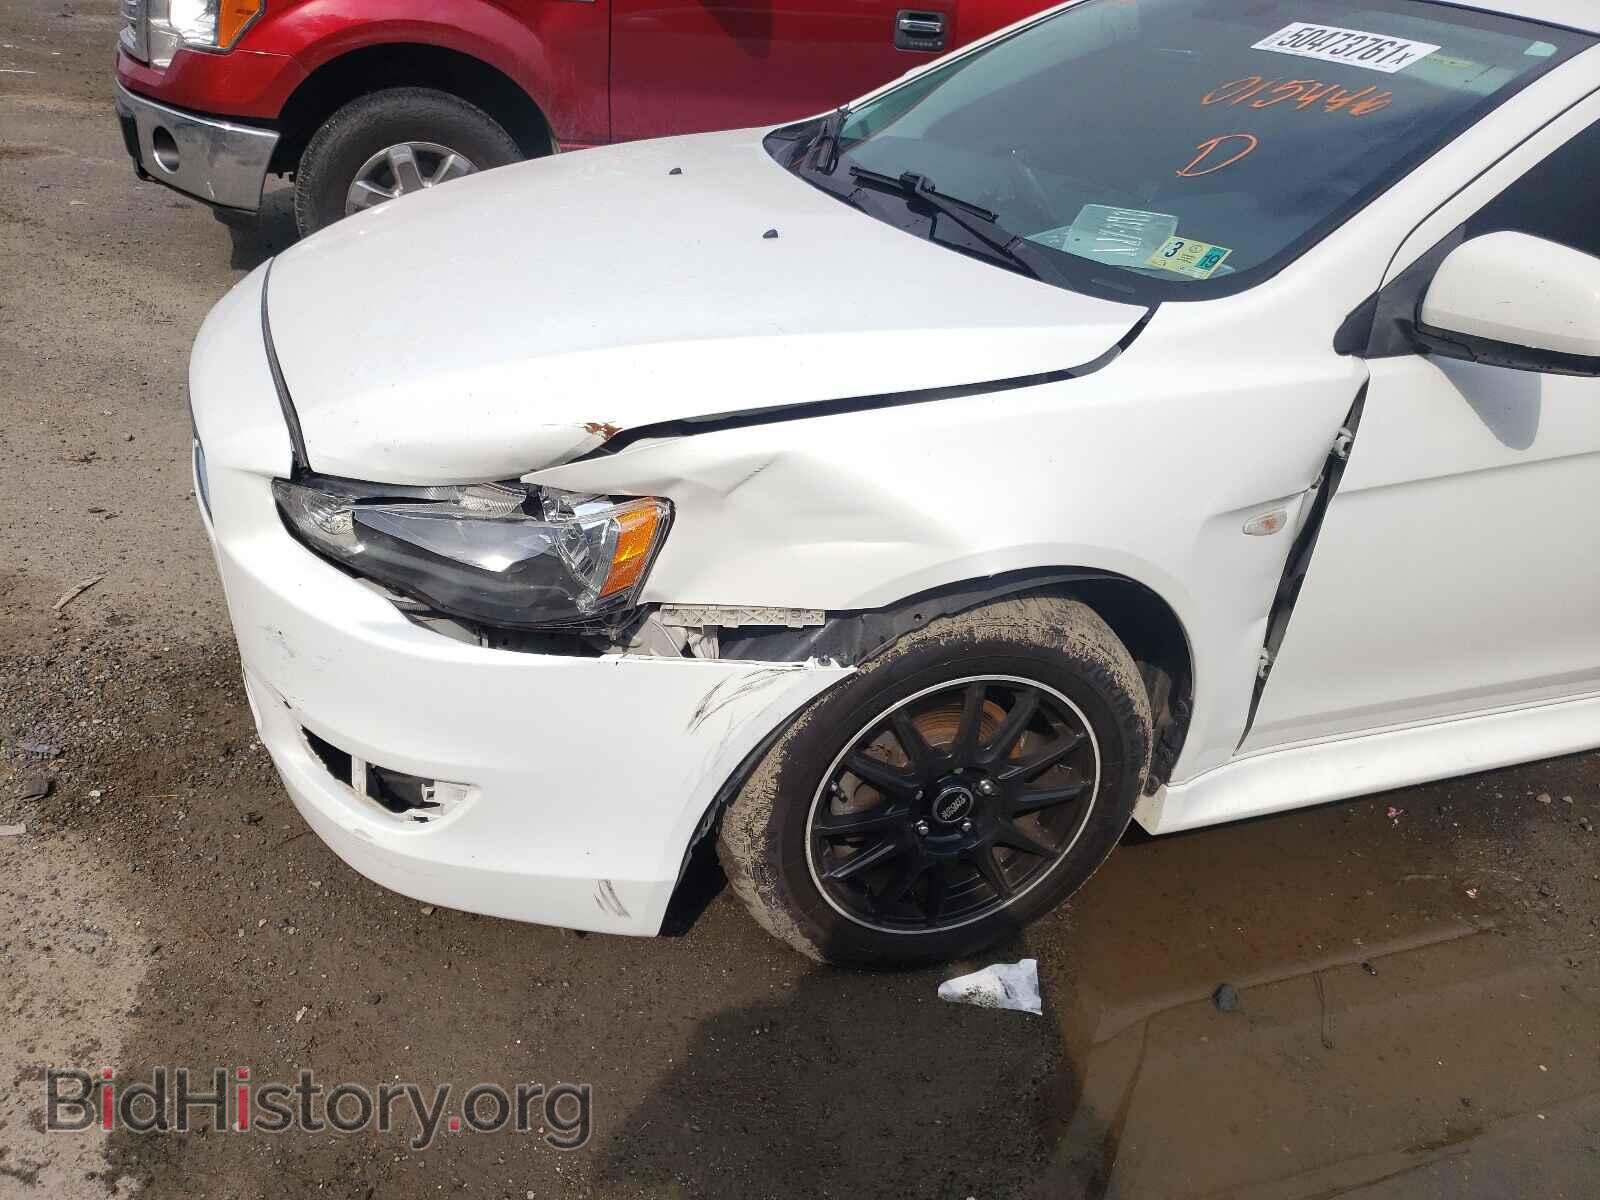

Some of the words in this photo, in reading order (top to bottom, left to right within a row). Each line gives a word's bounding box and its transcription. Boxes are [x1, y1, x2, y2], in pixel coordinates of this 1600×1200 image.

[1277, 27, 1412, 64] 50473761
[1175, 133, 1259, 178] D
[1164, 241, 1185, 258] 3
